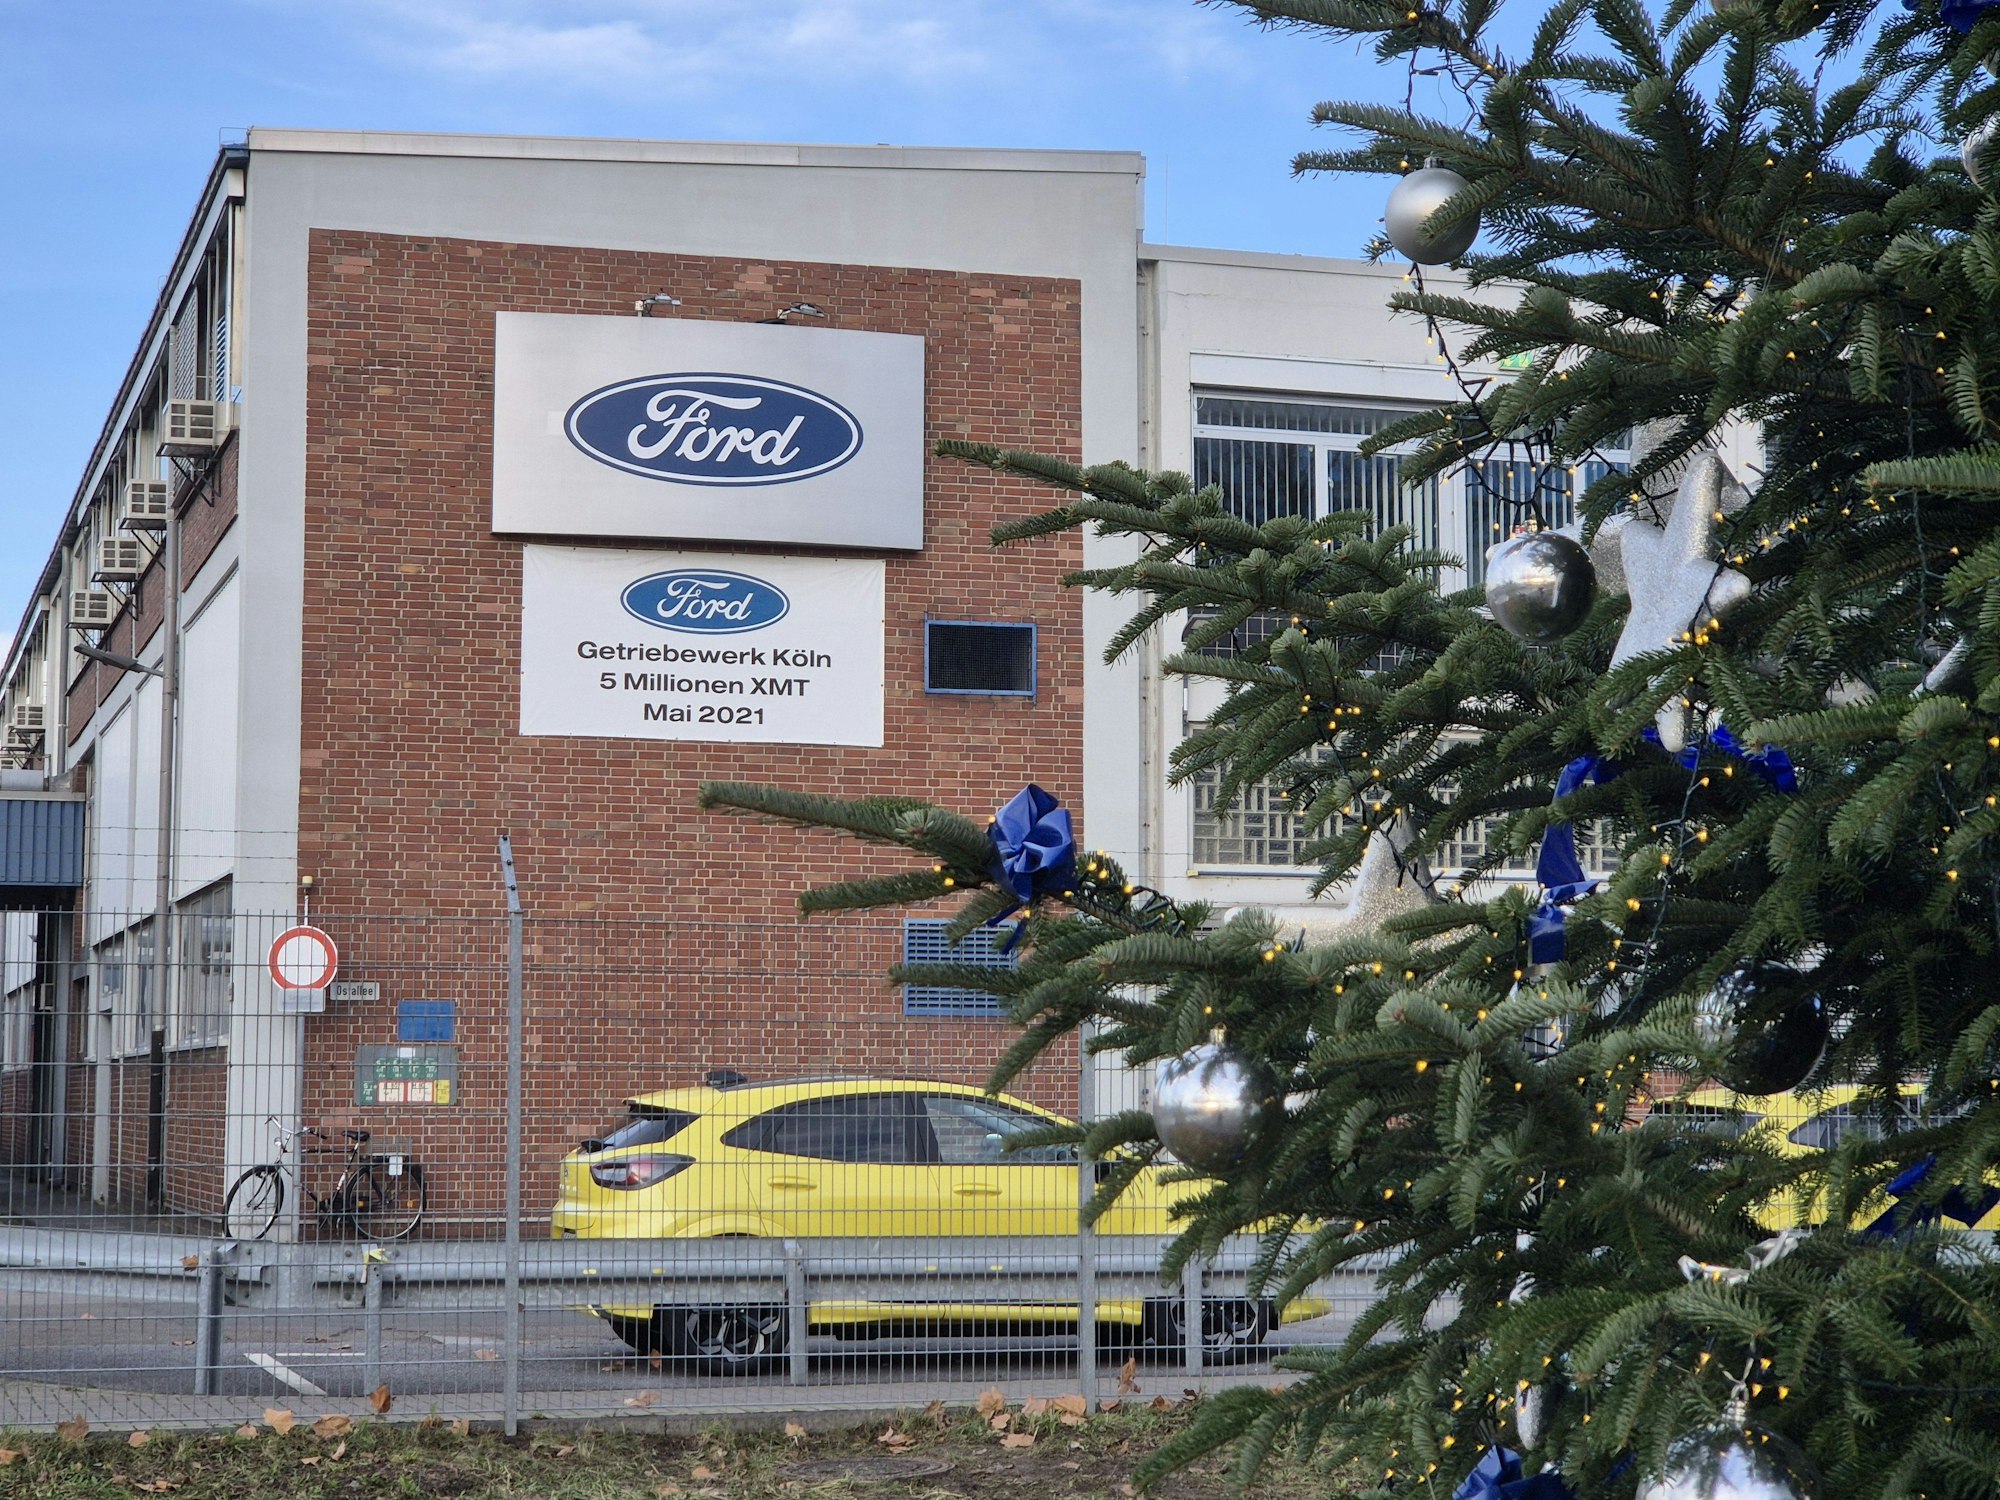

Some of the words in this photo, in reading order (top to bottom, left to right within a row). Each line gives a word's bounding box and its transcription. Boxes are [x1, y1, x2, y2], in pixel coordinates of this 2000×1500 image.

[627, 389, 805, 466] Ford
[656, 578, 754, 621] Ford
[577, 640, 766, 666] Getriebewerk
[773, 648, 832, 668] Köln
[600, 672, 617, 690] 5
[624, 673, 744, 695] Millionen
[750, 677, 810, 697] XMT
[643, 703, 692, 722] Mai
[698, 705, 764, 725] 2021
[336, 984, 374, 996] Osallee
